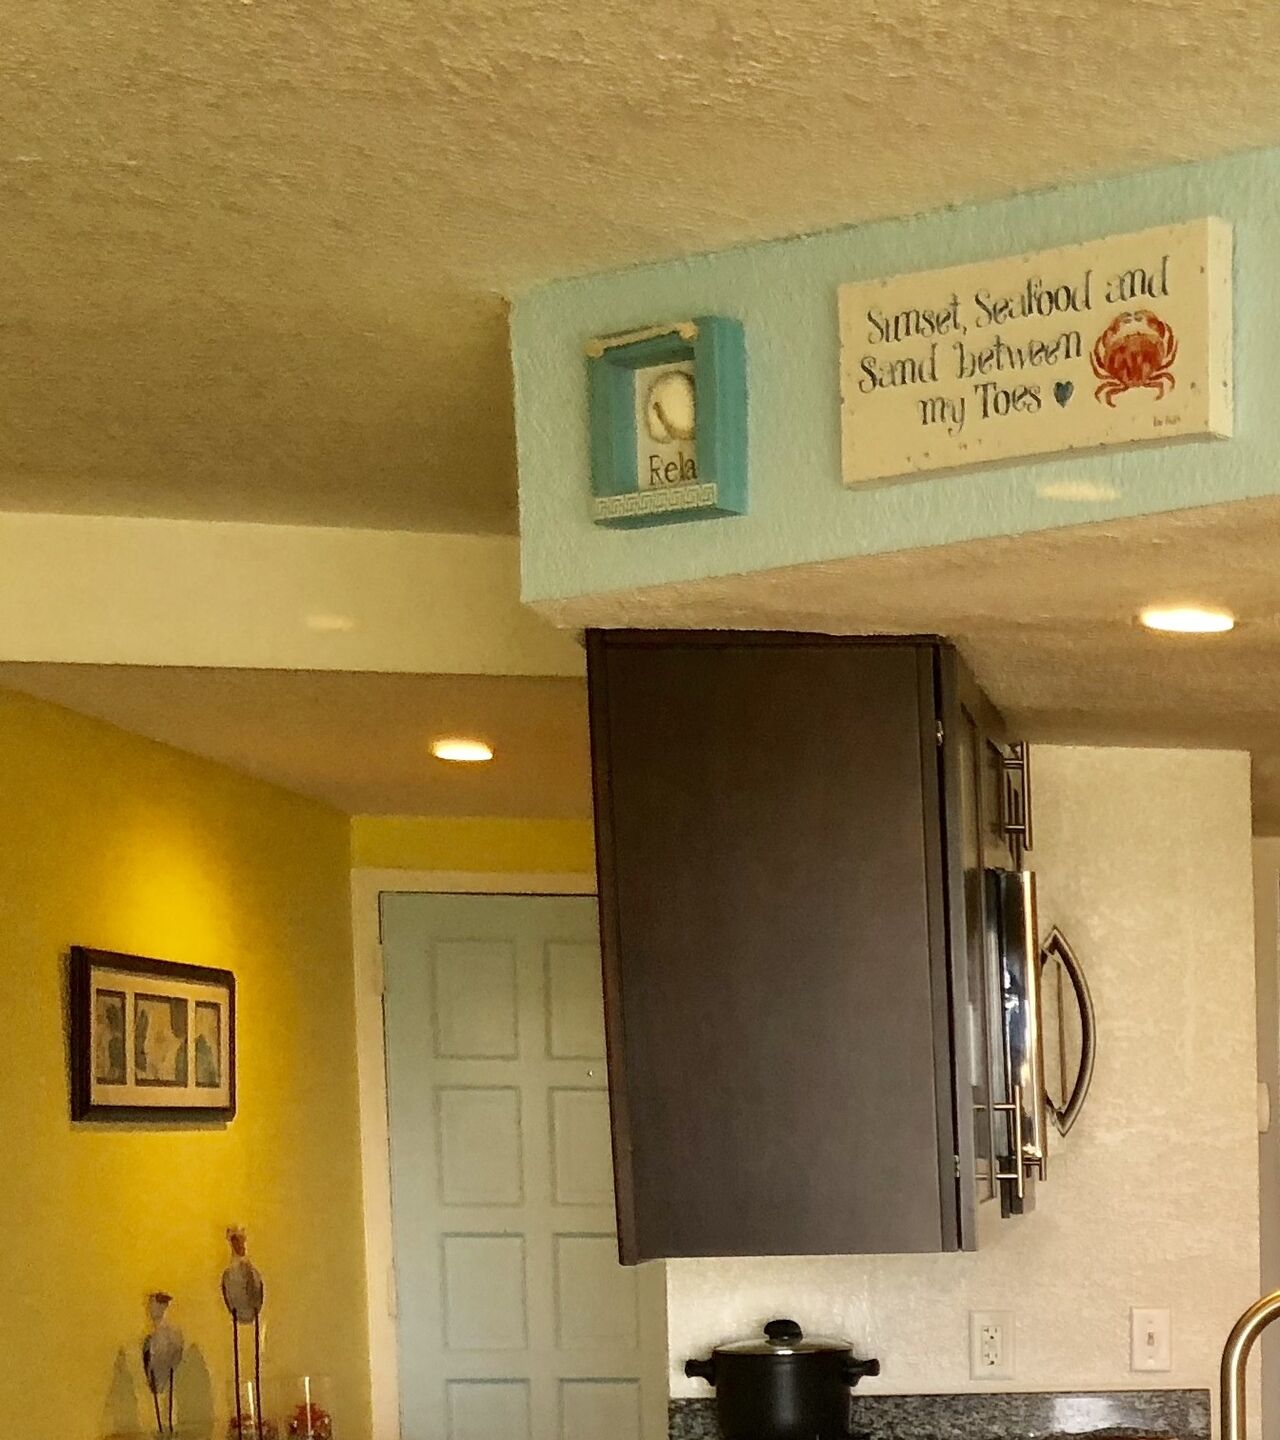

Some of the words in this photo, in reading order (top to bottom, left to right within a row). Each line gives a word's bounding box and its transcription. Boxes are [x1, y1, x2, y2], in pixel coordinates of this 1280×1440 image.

[866, 292, 967, 346] Sunset,
[975, 269, 1093, 329] Seafood
[1105, 254, 1169, 303] and
[858, 341, 939, 394] Sand
[952, 329, 1083, 380] between
[918, 392, 966, 438] my
[974, 379, 1042, 420] Toes
[649, 451, 697, 486] Rela
